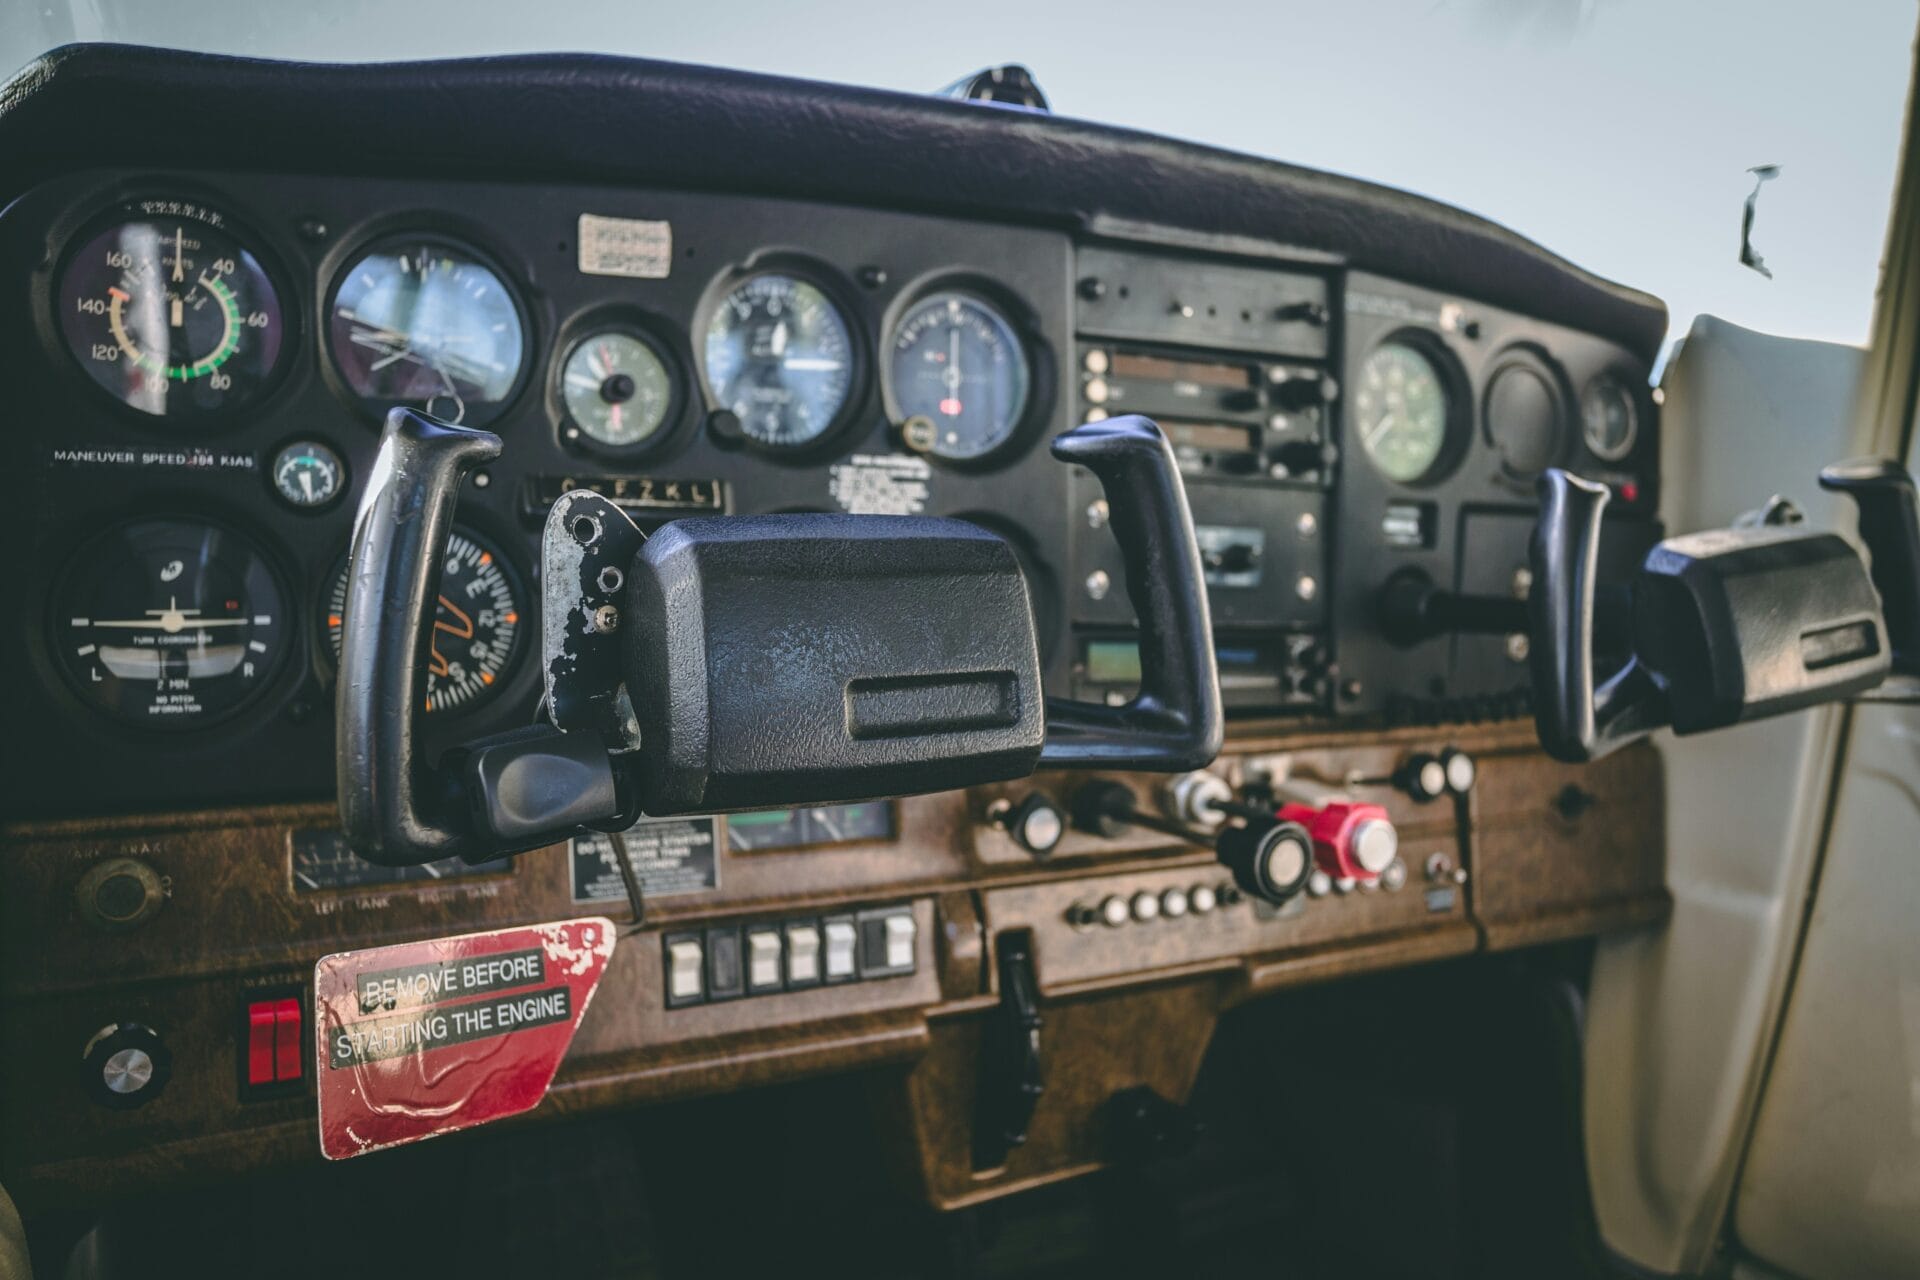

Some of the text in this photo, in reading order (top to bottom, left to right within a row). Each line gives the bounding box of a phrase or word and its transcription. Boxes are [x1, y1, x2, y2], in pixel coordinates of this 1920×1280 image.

[106, 251, 132, 269] 160
[212, 257, 236, 275] 40
[77, 296, 105, 315] 140
[247, 313, 269, 329] 60
[91, 344, 118, 361] 120
[209, 374, 231, 390] 80
[54, 450, 135, 464] MANEUVER
[142, 452, 186, 466] SPEED
[220, 455, 254, 468] KIAS
[466, 578, 487, 599] E
[477, 609, 497, 629] 12
[91, 666, 103, 682] L
[243, 661, 255, 678] R
[448, 660, 467, 683] S
[156, 679, 190, 691] 2 MIN
[156, 695, 195, 705] NO PITCH
[149, 704, 202, 714] INFORMATION
[355, 897, 391, 910] TANK
[365, 955, 540, 1006] REMOVE BEFORE
[336, 993, 567, 1059] STARTING THE ENGINE
